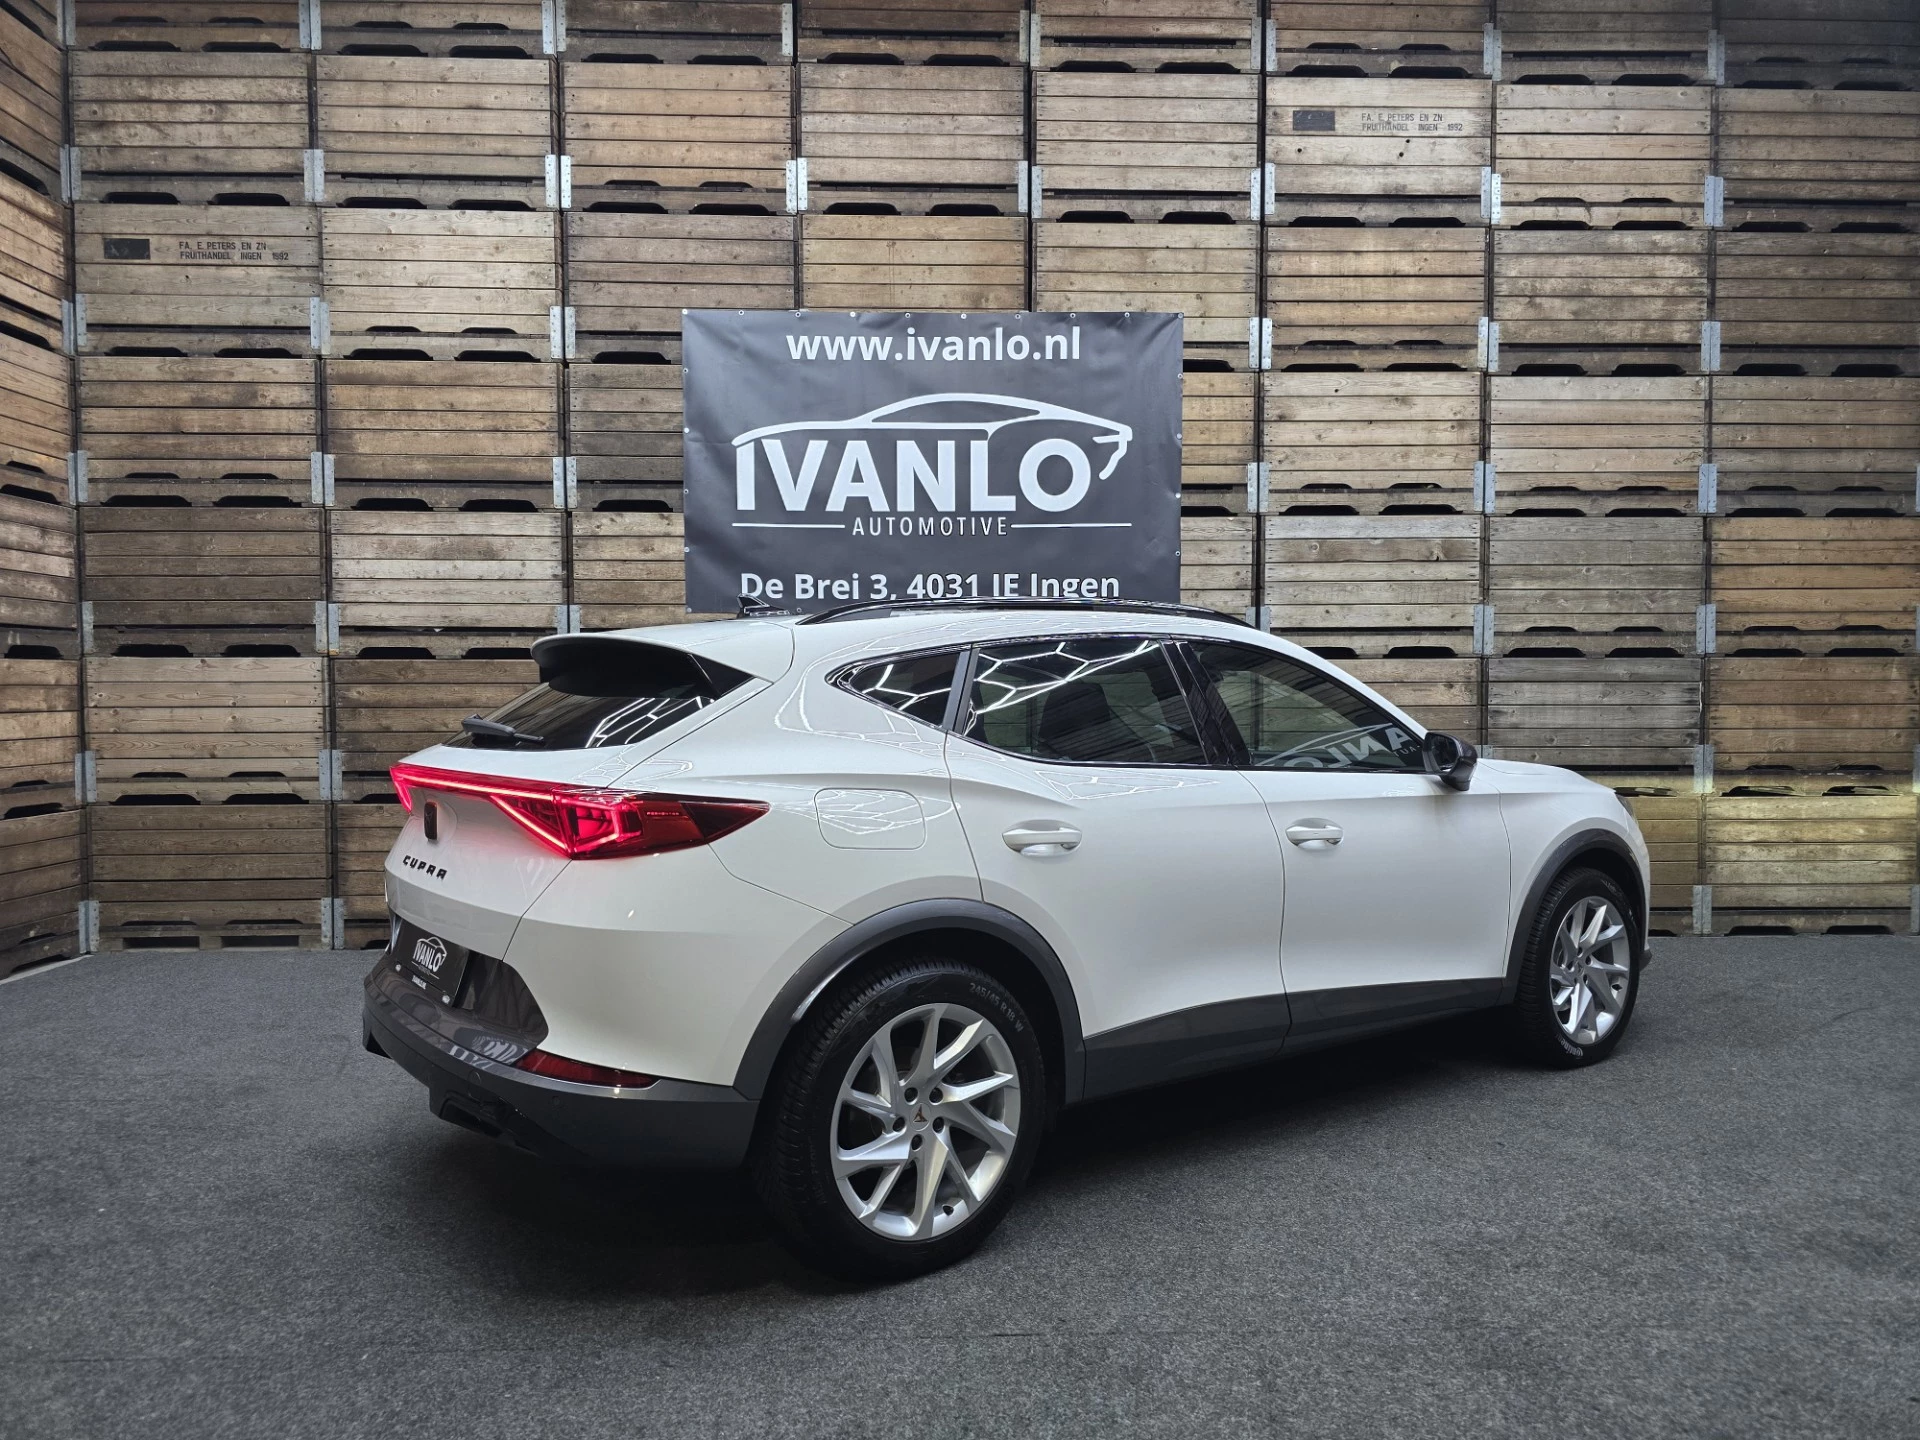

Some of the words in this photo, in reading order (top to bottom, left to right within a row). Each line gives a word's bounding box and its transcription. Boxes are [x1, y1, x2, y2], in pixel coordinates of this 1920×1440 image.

[1362, 123, 1409, 131] FRUITHANDEL
[1387, 113, 1415, 121] PETERS
[180, 251, 231, 260] FRUITHANDEL
[240, 252, 262, 260] INGEN
[206, 242, 236, 250] PETERS
[241, 242, 251, 250] EN
[256, 242, 267, 250] ZN
[786, 327, 1080, 361] www.ivanlo.nl
[736, 438, 1092, 512] IVANLO
[852, 516, 1007, 537] AUTOMOTIVE
[740, 572, 784, 599] De
[794, 572, 860, 599] Brei
[869, 573, 897, 601] 3,
[906, 573, 979, 599] 4031
[1030, 572, 1120, 598] Ingen
[402, 854, 448, 881] CUPRA
[412, 941, 442, 972] IVANLO
